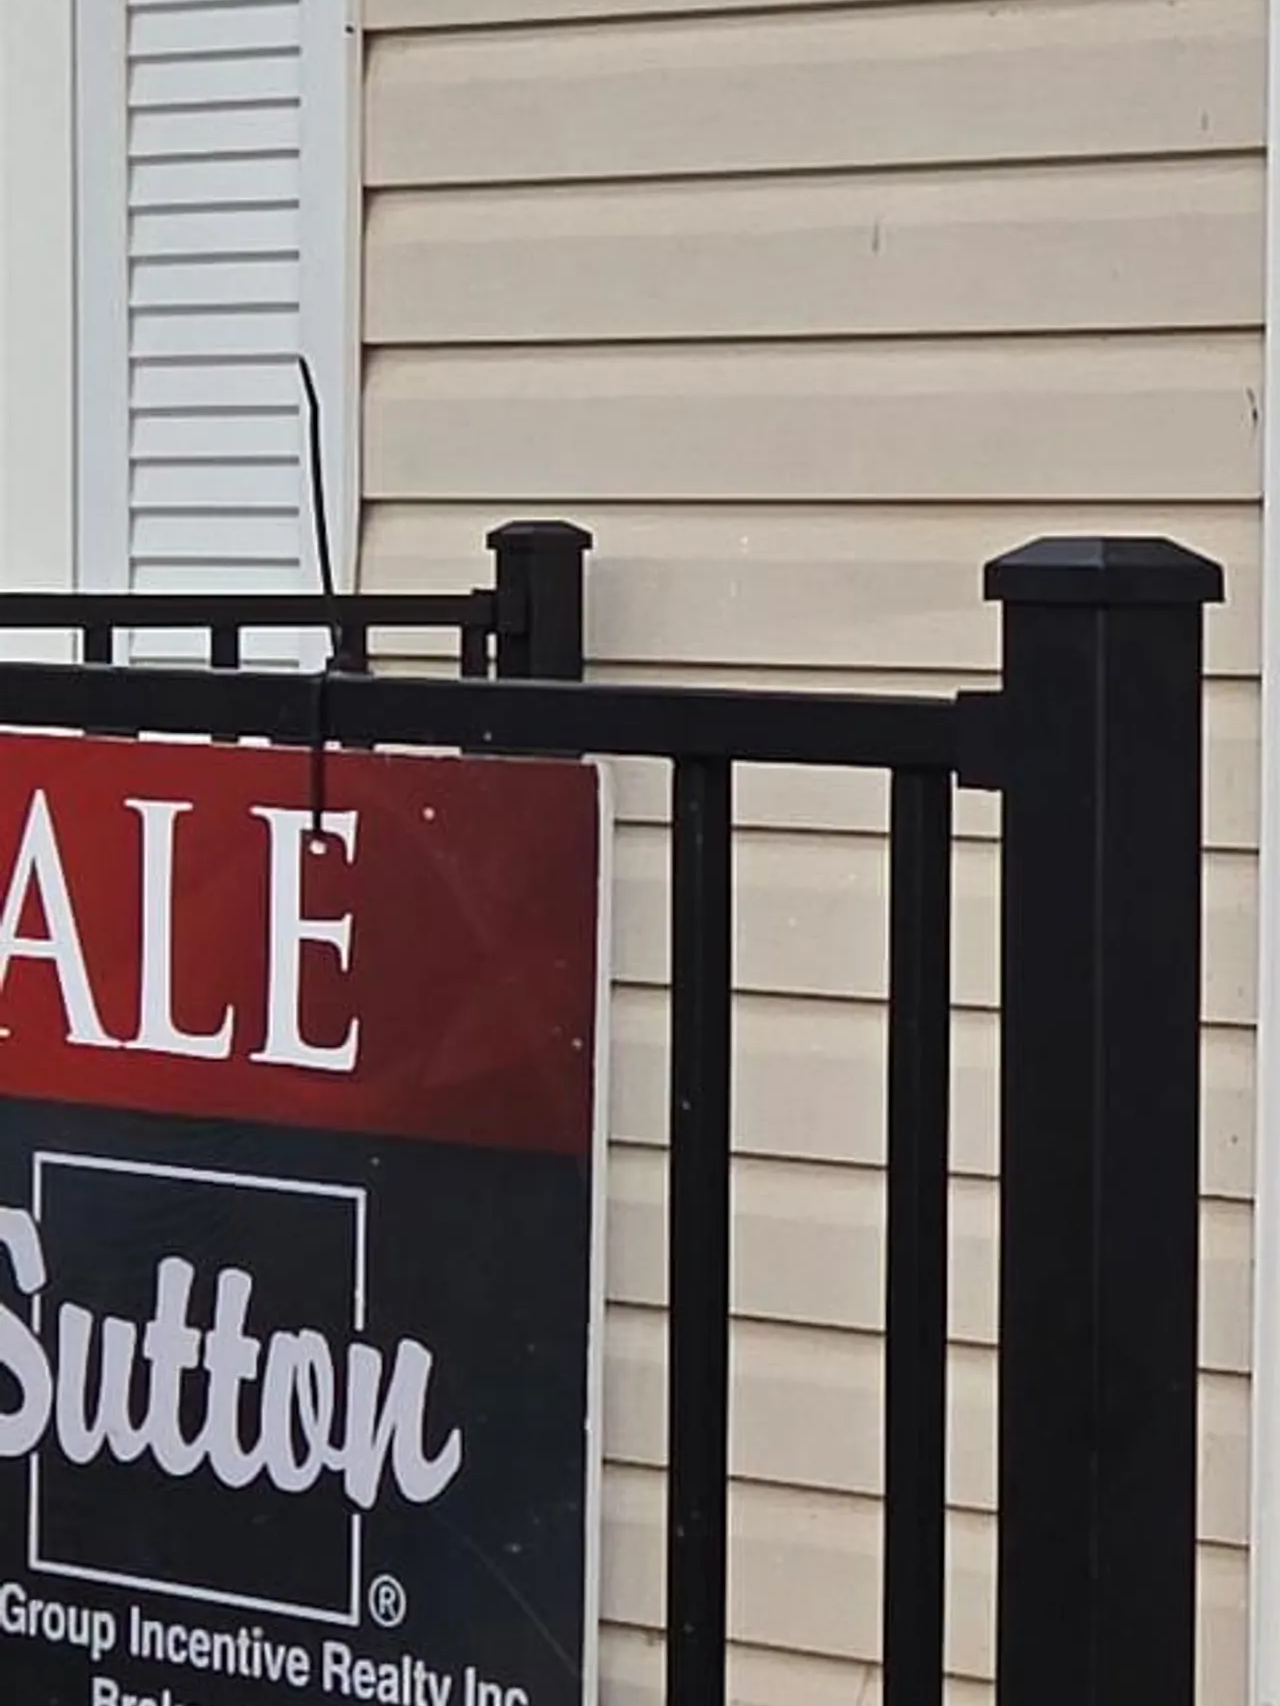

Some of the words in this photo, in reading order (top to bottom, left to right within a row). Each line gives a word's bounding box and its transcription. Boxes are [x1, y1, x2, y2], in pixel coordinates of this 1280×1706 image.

[0, 788, 361, 1073] ALE
[0, 1207, 463, 1510] Sutton
[0, 1582, 116, 1661] Group
[130, 1606, 309, 1687] Incentive
